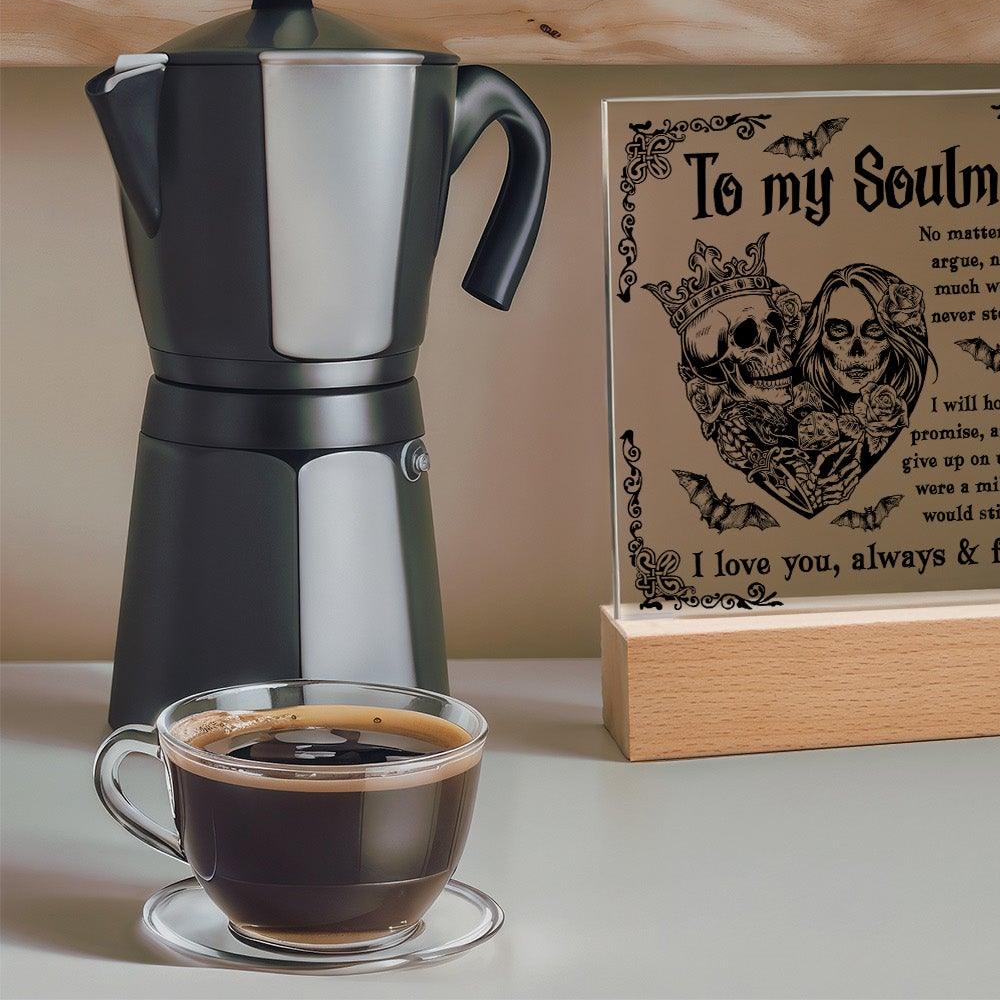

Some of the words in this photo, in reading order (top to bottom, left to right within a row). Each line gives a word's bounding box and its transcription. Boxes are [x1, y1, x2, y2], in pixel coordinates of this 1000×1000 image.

[682, 151, 743, 221] To
[760, 166, 835, 228] my
[918, 225, 942, 242] No
[931, 255, 985, 274] argue,
[933, 277, 981, 296] much
[930, 310, 977, 324] never
[930, 396, 938, 413] I
[942, 394, 978, 413] will
[909, 422, 985, 447] promise,
[901, 452, 938, 475] give
[942, 453, 965, 472] up
[970, 454, 991, 467] on
[914, 482, 955, 496] were
[960, 482, 970, 495] a
[922, 503, 975, 523] would
[691, 550, 705, 578] I
[713, 548, 771, 578] love
[780, 553, 841, 582] you,
[851, 541, 946, 576] always
[957, 537, 980, 566] &
